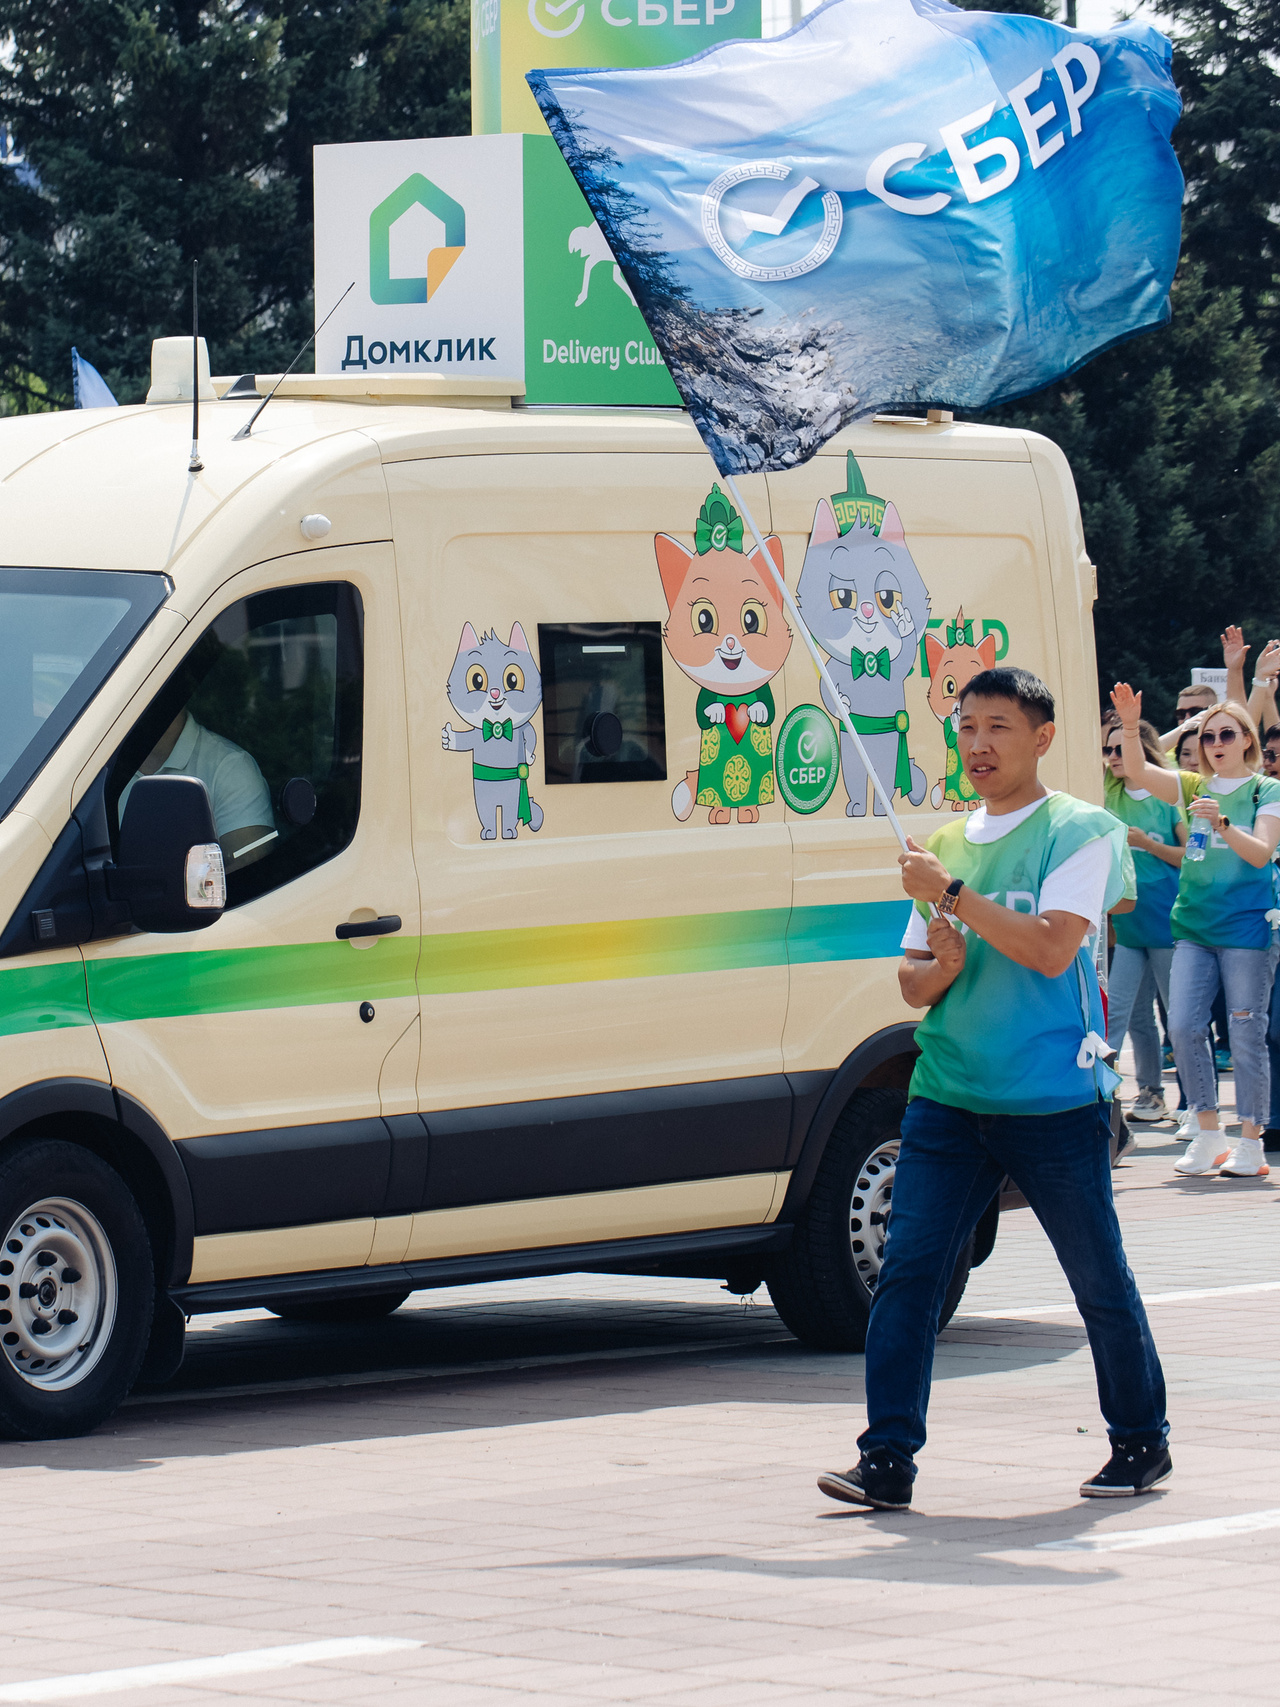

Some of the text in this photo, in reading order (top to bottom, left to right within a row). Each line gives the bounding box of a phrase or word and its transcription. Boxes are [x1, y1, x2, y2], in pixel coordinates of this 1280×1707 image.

[600, 0, 735, 27] СБЕР
[866, 42, 1101, 216] СБЕР
[542, 339, 620, 370] Delivery
[789, 766, 826, 785] СБЕР
